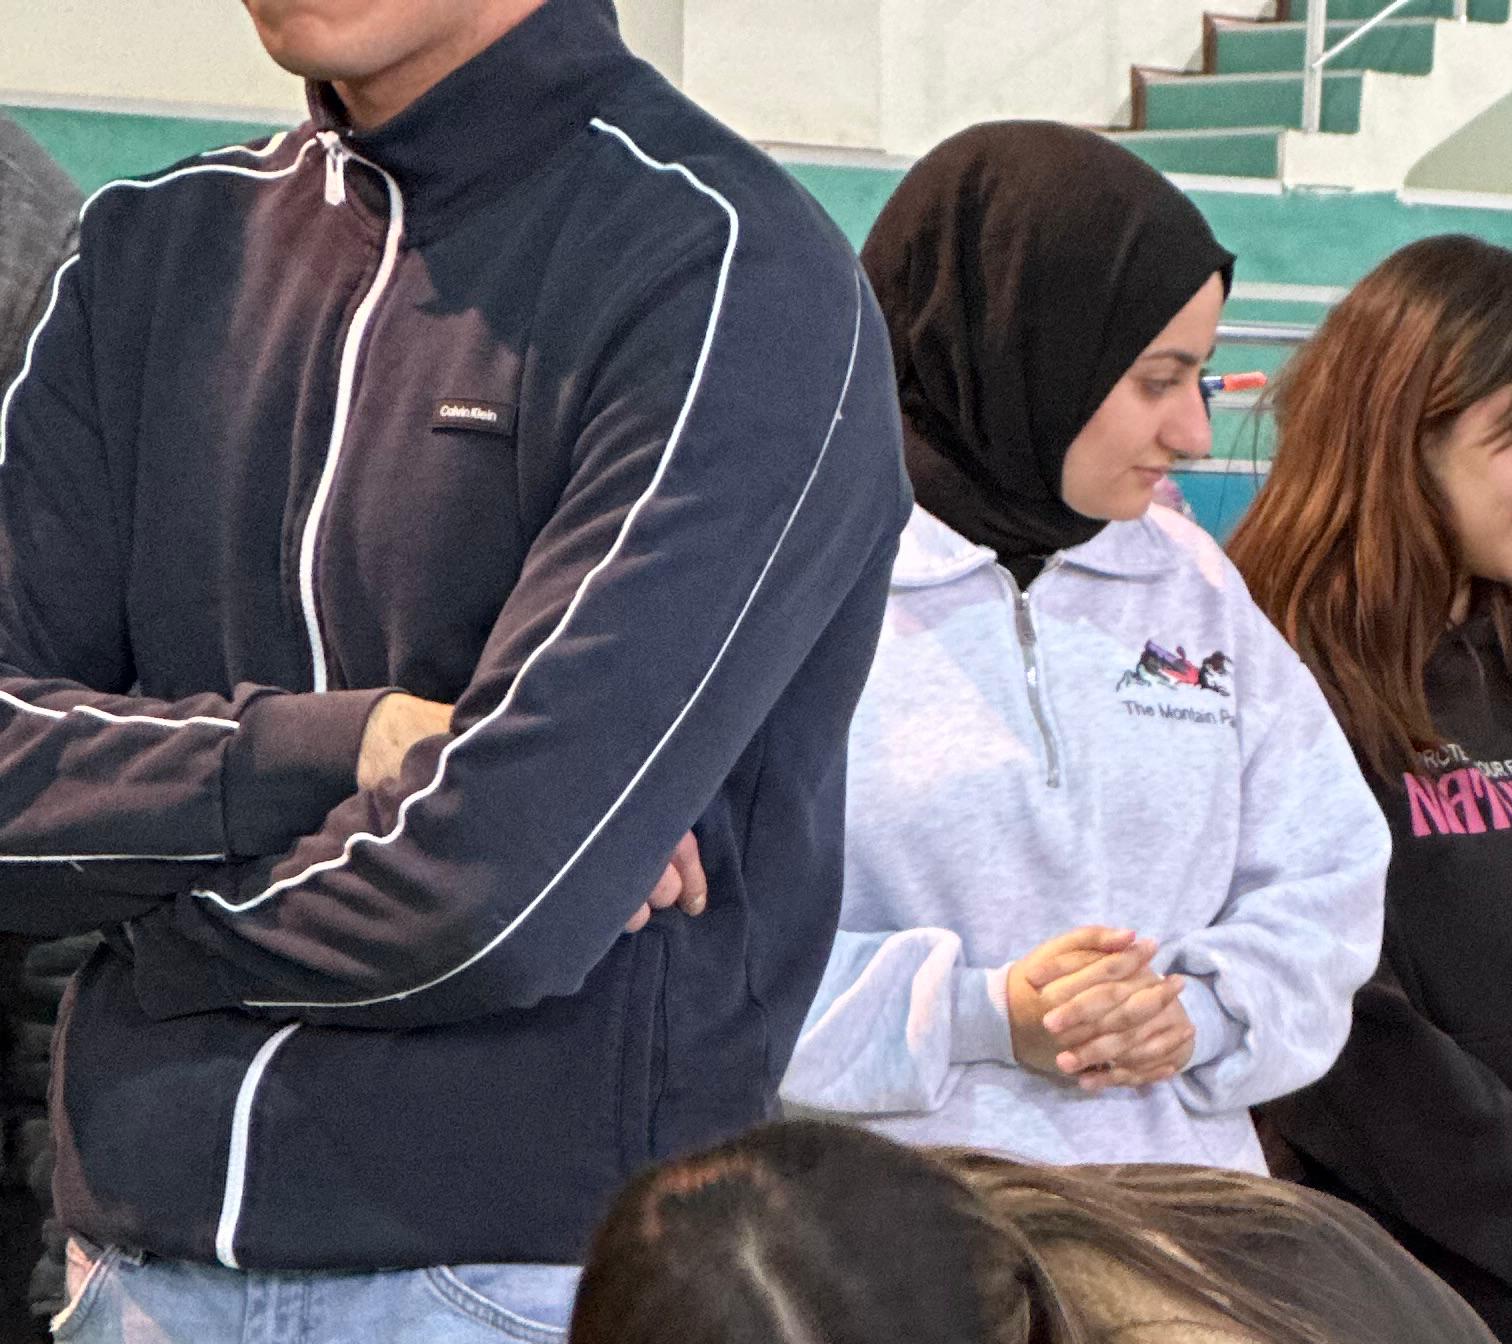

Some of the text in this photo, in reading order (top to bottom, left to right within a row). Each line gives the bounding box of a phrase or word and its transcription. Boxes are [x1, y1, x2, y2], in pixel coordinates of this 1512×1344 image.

[440, 405, 497, 422] Calvin Klein
[1121, 700, 1154, 717] The
